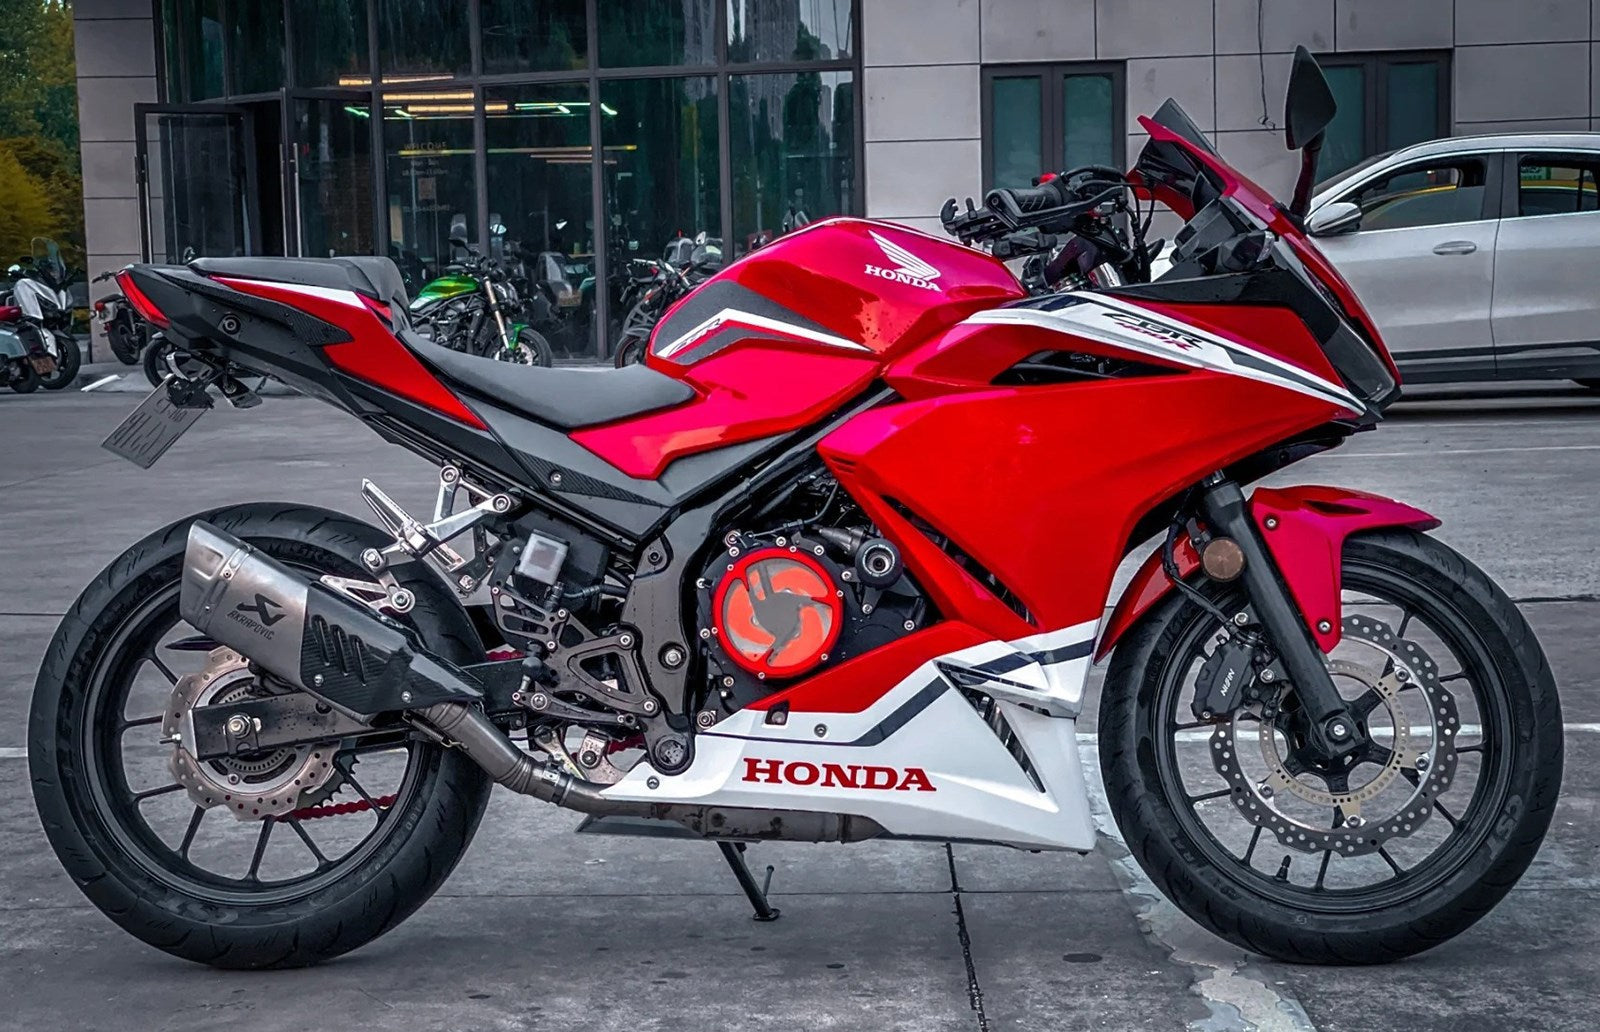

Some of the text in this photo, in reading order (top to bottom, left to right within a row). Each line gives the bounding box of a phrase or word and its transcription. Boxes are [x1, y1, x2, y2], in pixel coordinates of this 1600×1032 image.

[864, 264, 943, 292] HONDA
[1102, 312, 1203, 350] CBR
[742, 757, 937, 792] HONDA
